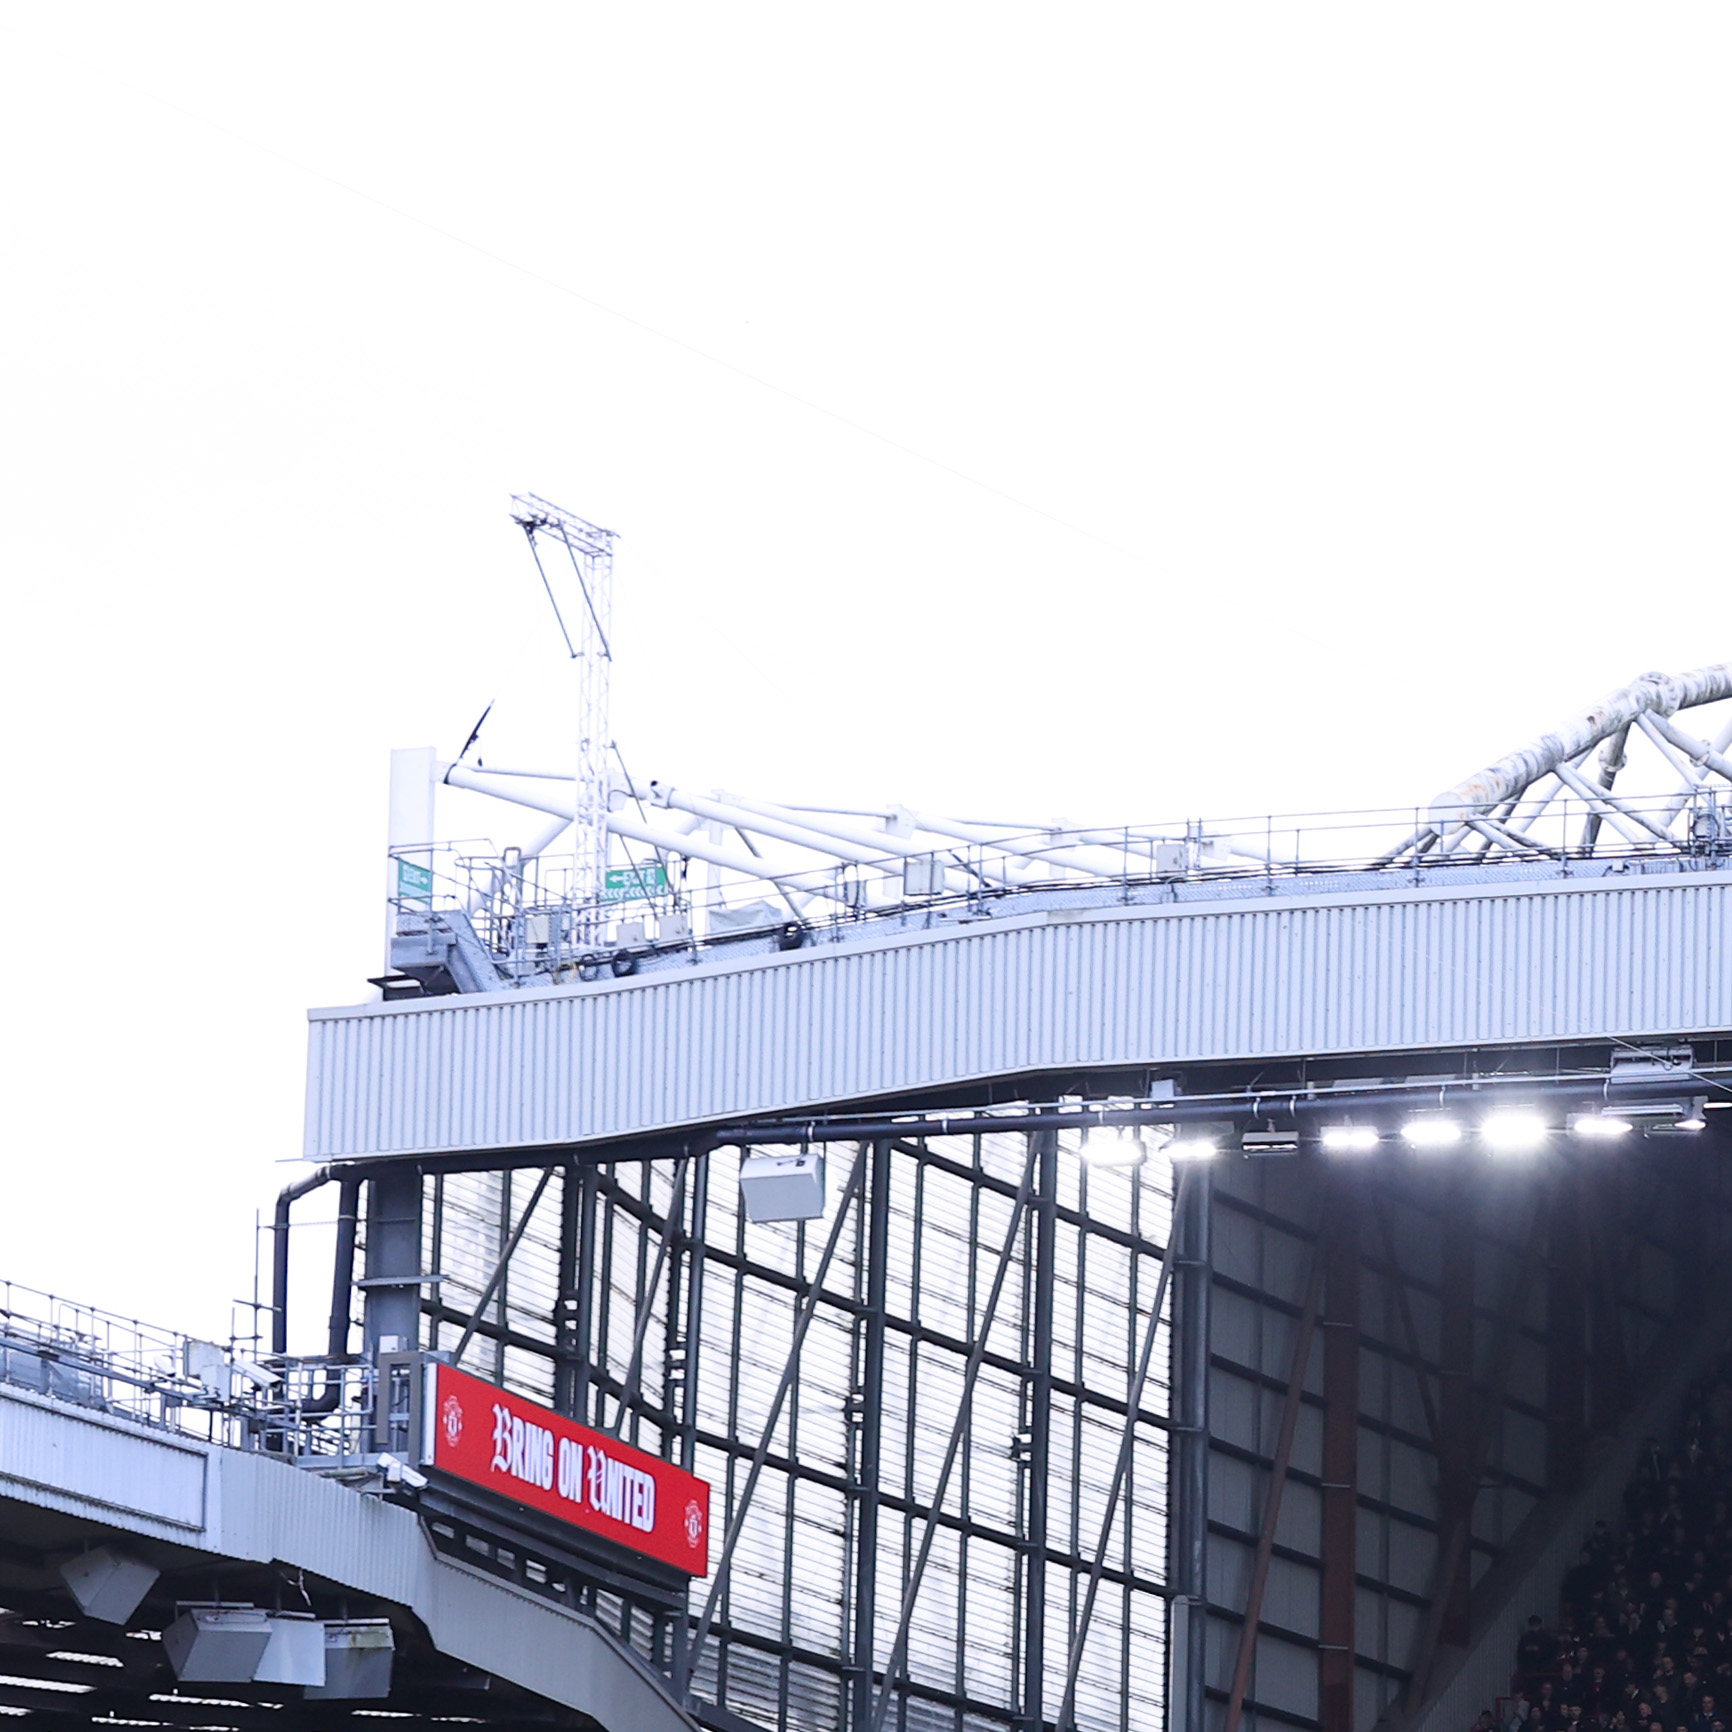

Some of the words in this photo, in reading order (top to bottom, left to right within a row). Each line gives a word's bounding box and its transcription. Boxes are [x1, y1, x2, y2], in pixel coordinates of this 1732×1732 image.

[491, 1403, 554, 1491] BRING
[558, 1437, 583, 1503] ON
[587, 1446, 656, 1533] UNITED
